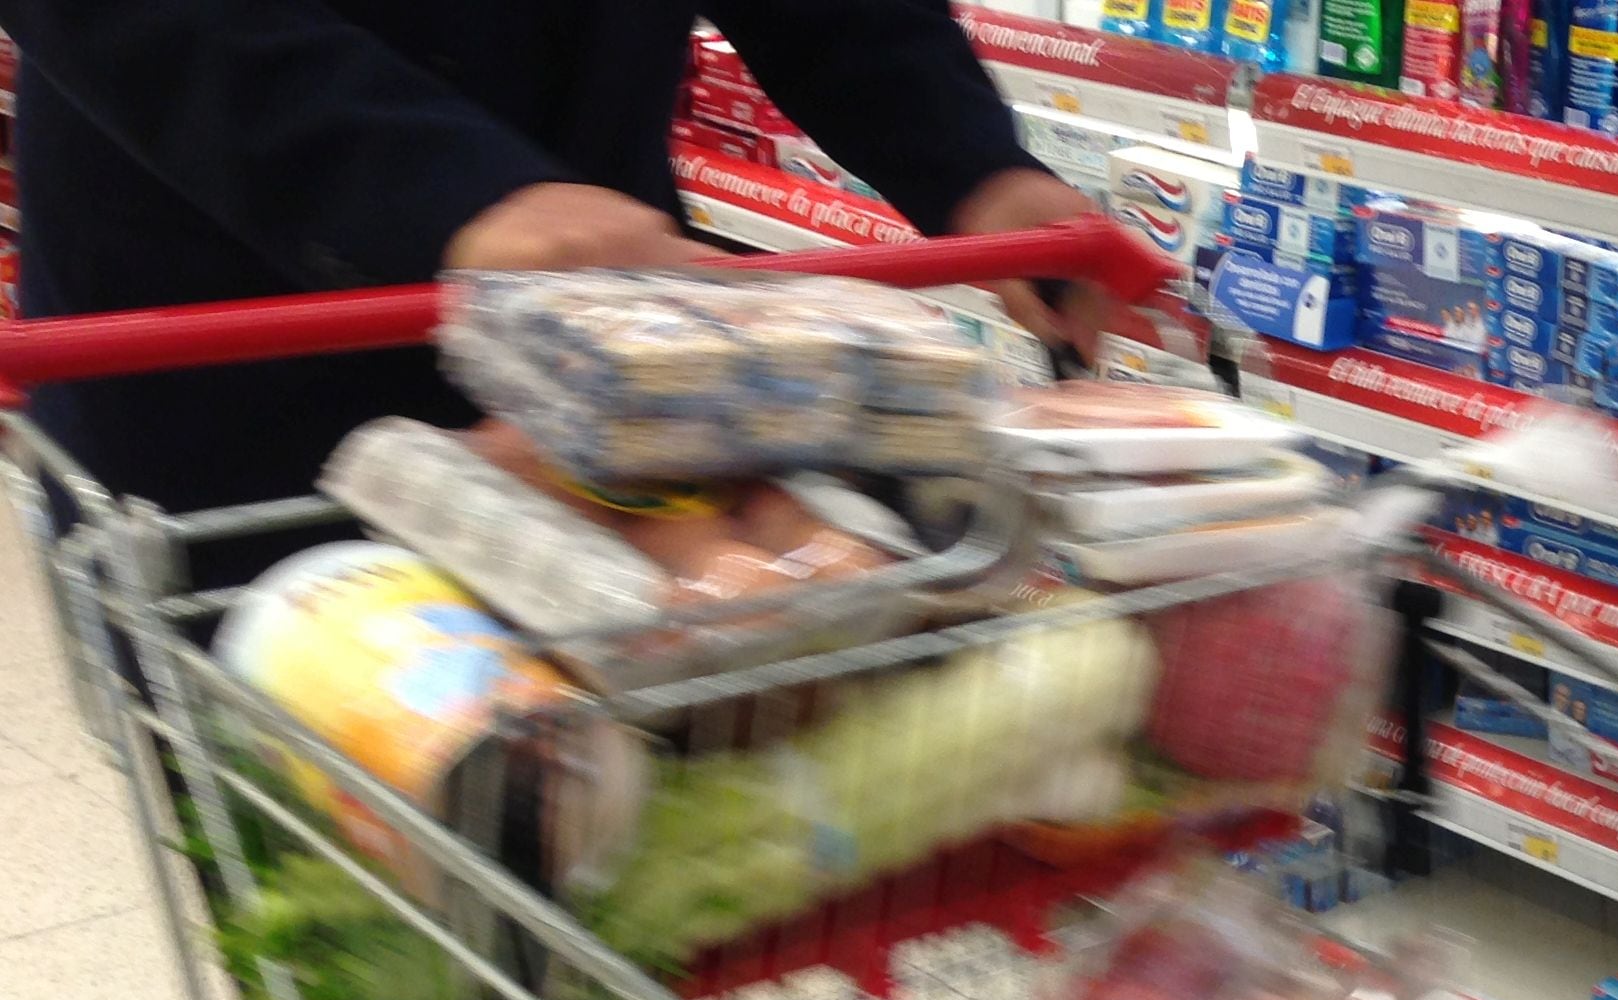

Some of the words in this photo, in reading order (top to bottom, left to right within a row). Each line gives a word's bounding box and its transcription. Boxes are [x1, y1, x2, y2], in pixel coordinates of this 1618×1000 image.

[1527, 138, 1565, 168] que
[700, 166, 788, 209] remueve
[788, 188, 812, 216] la
[811, 194, 870, 237] placa
[1555, 591, 1599, 619] por
